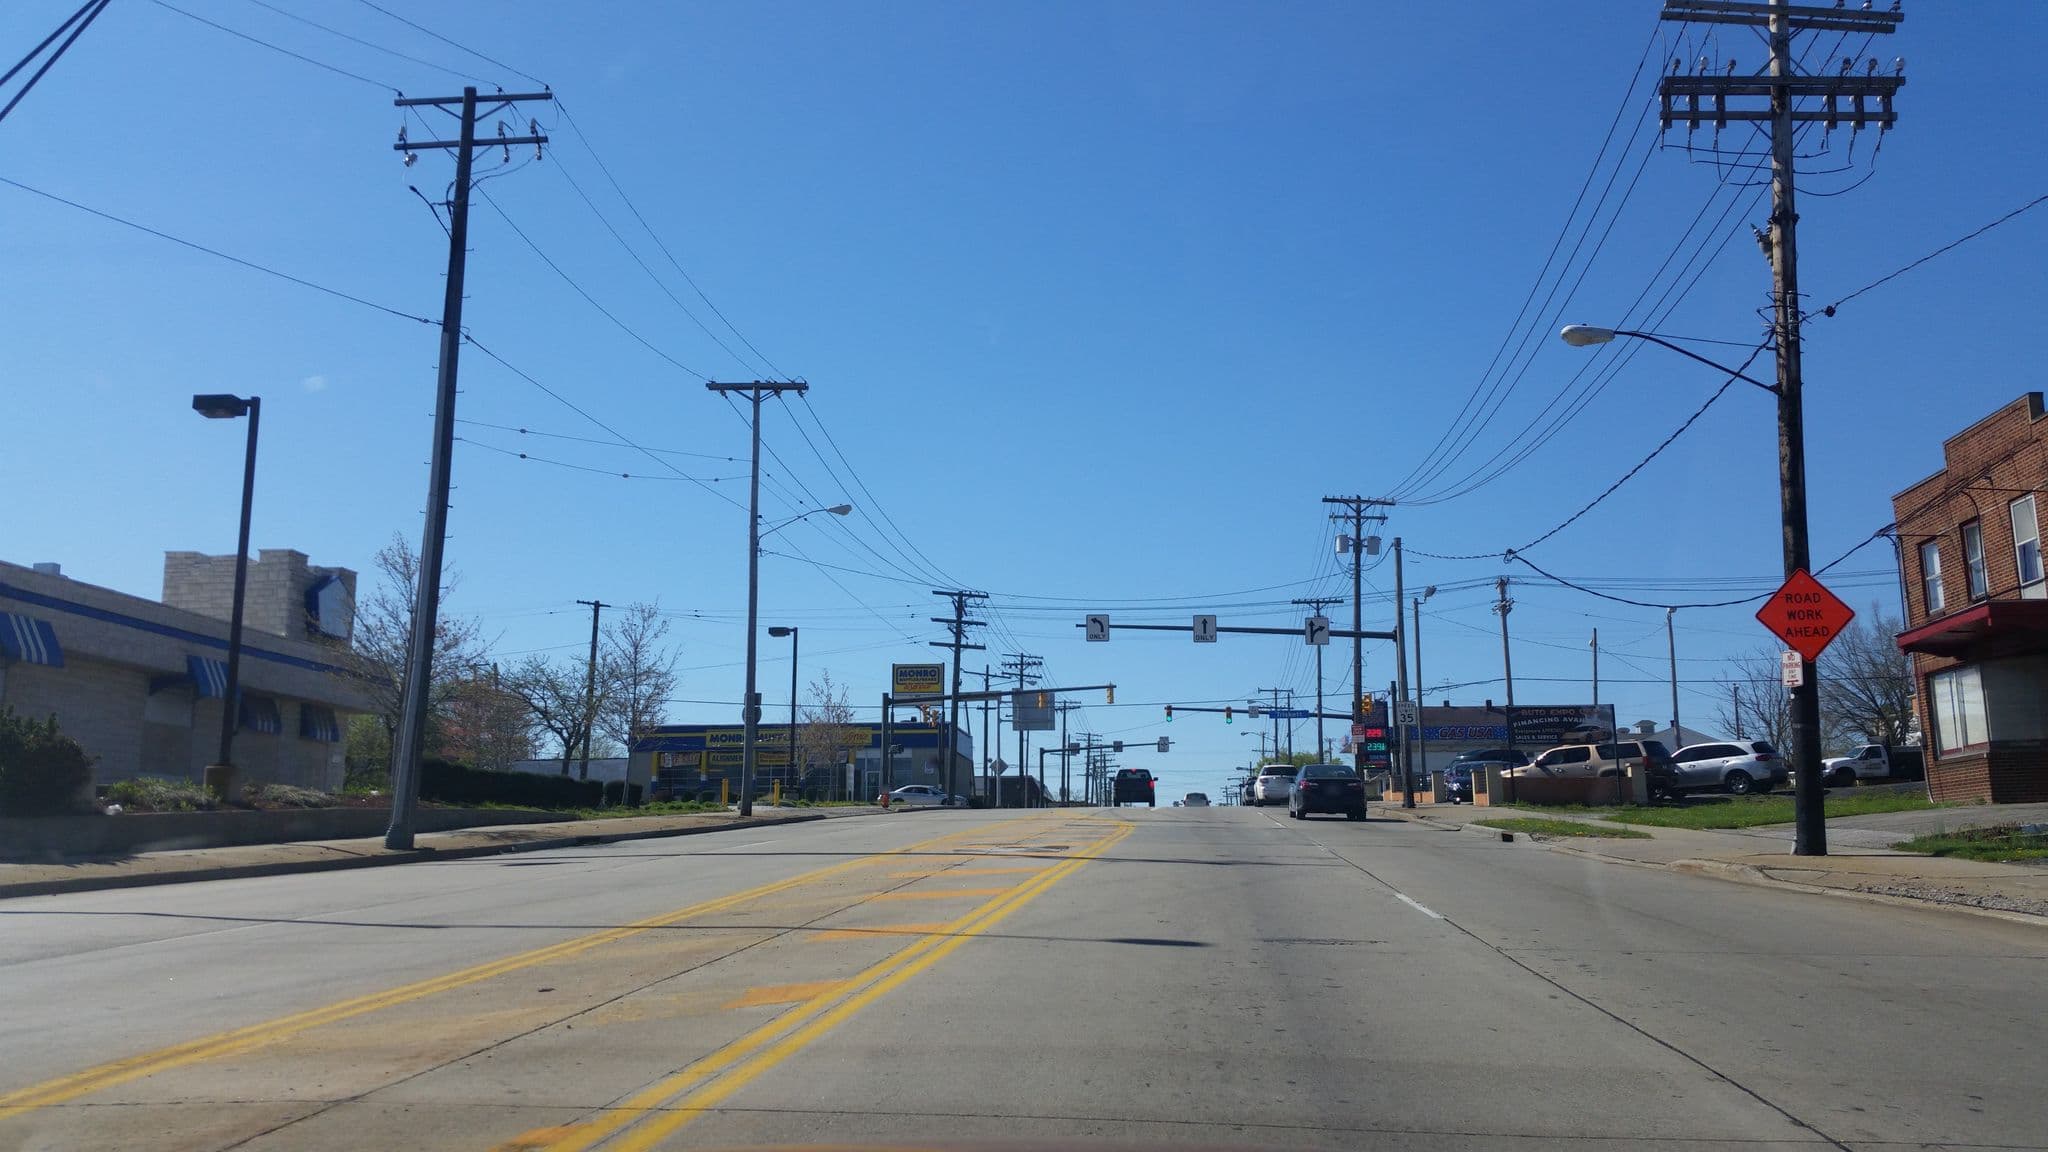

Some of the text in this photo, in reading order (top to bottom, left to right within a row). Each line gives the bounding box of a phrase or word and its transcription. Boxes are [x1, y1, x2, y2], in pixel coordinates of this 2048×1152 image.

[1785, 593, 1821, 604] ROAD
[1787, 609, 1824, 620] WORK
[1785, 626, 1829, 637] AHEAD
[899, 669, 937, 677] MONRO
[1400, 713, 1414, 723] 35
[1513, 716, 1560, 728] FINANCING
[1439, 726, 1493, 738] GAS USA
